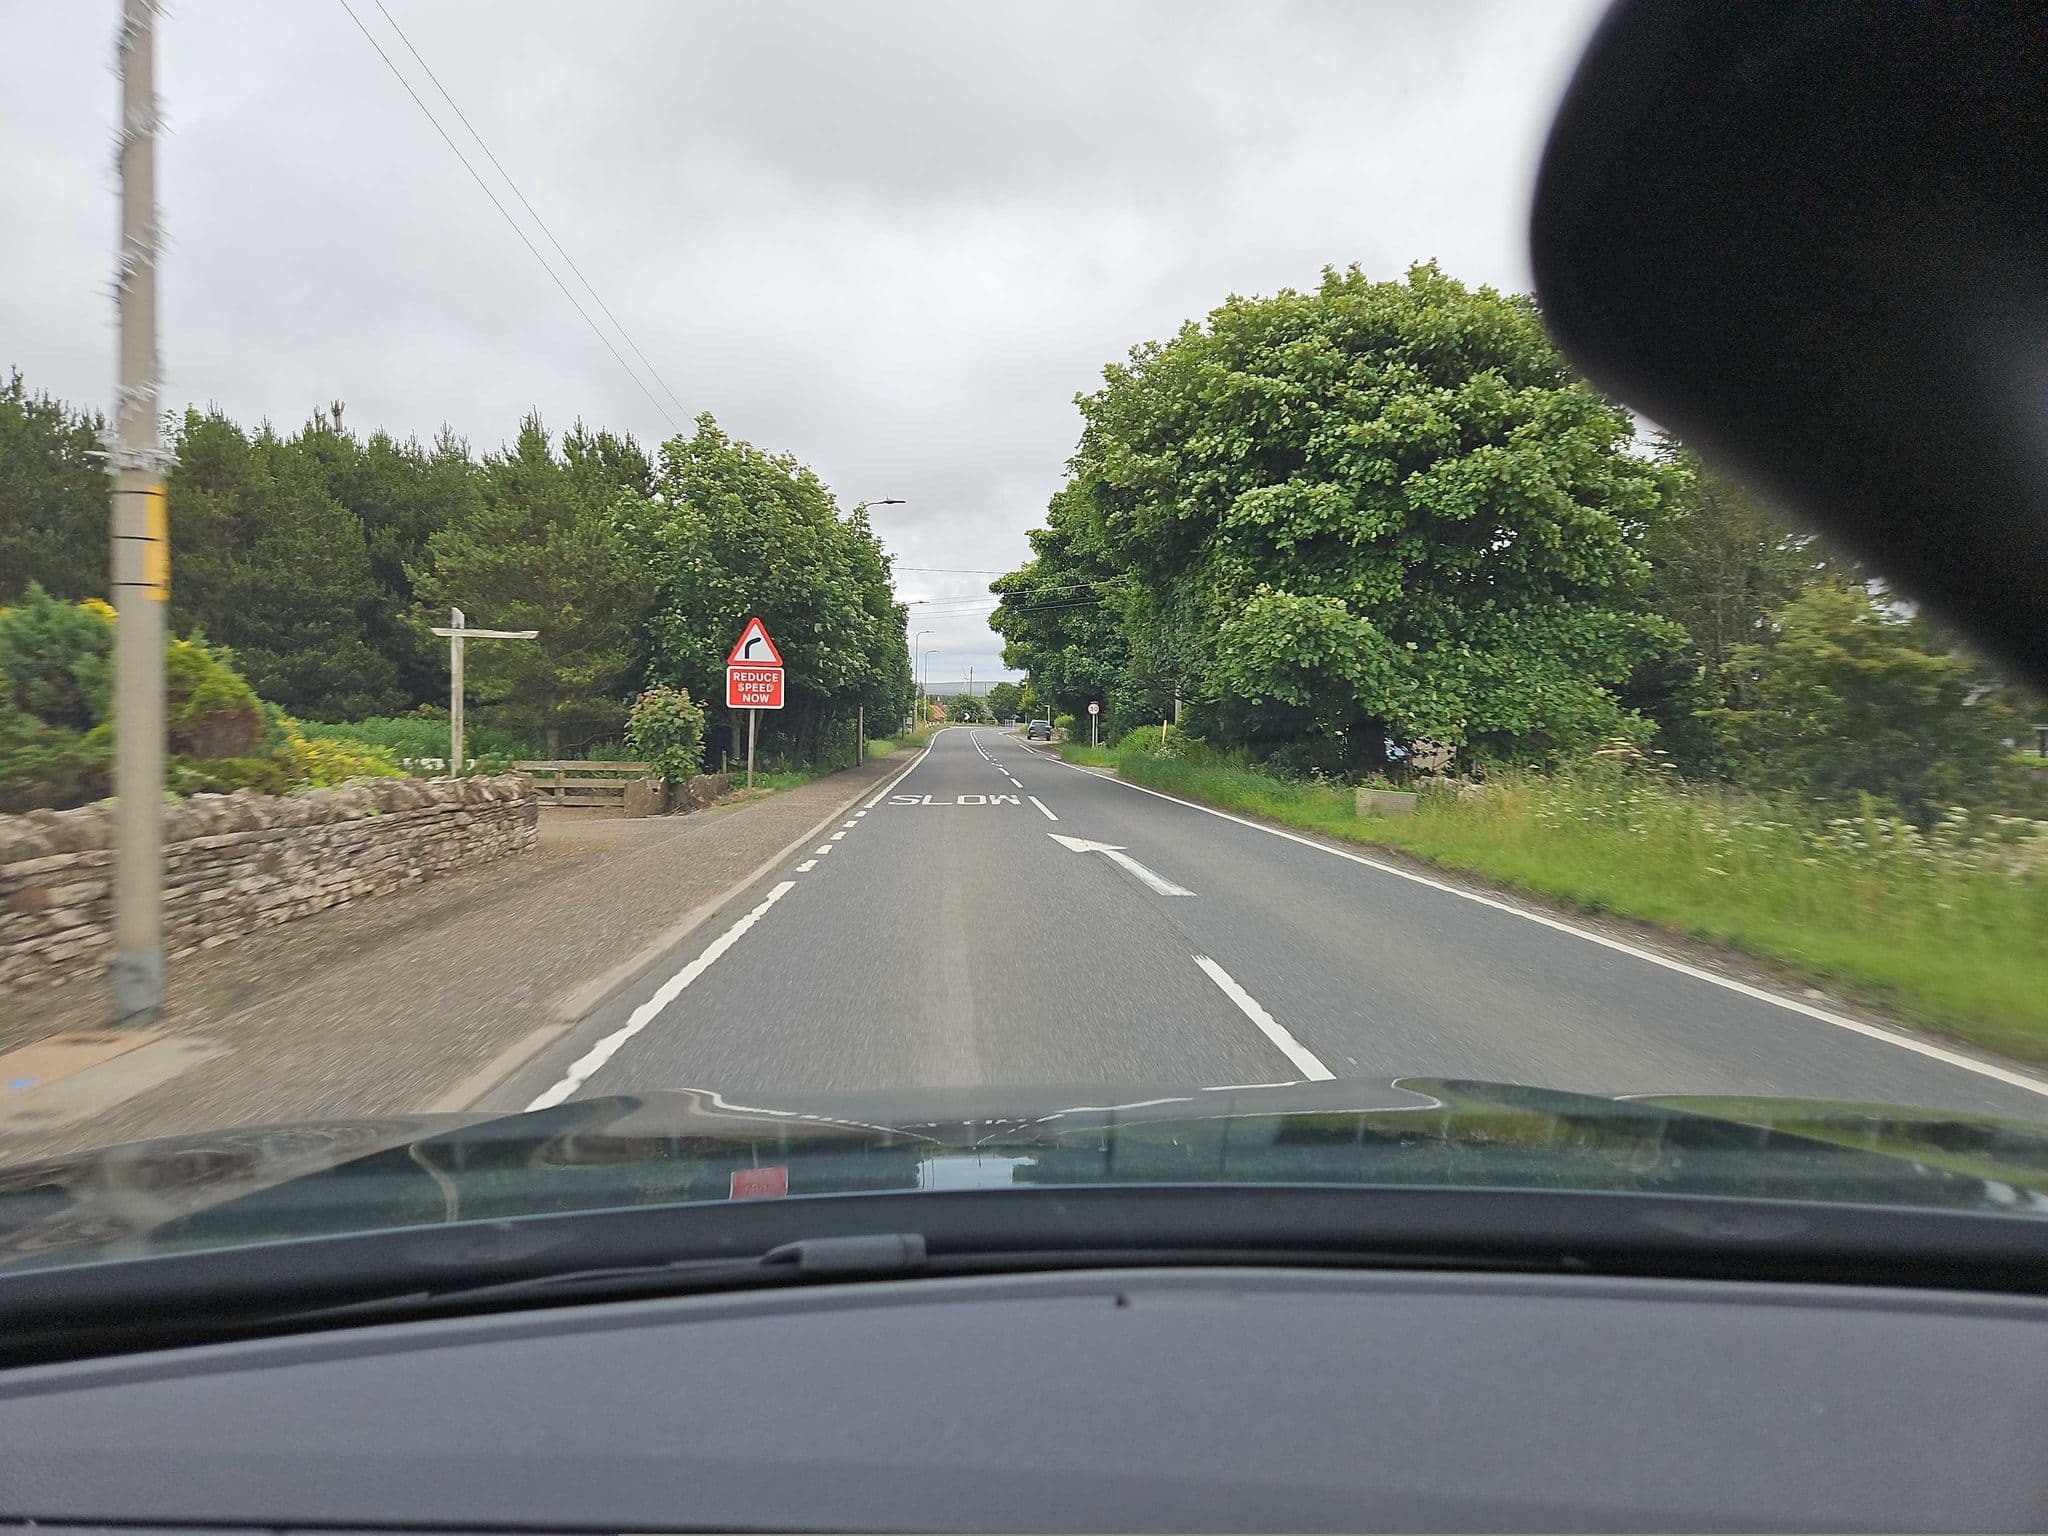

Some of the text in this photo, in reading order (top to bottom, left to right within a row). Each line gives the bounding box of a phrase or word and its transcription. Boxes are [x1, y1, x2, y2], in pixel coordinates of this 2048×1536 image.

[733, 672, 779, 682] REDUCE
[737, 683, 774, 692] SPEED
[742, 693, 770, 703] NOW
[888, 794, 1022, 805] SLOW
